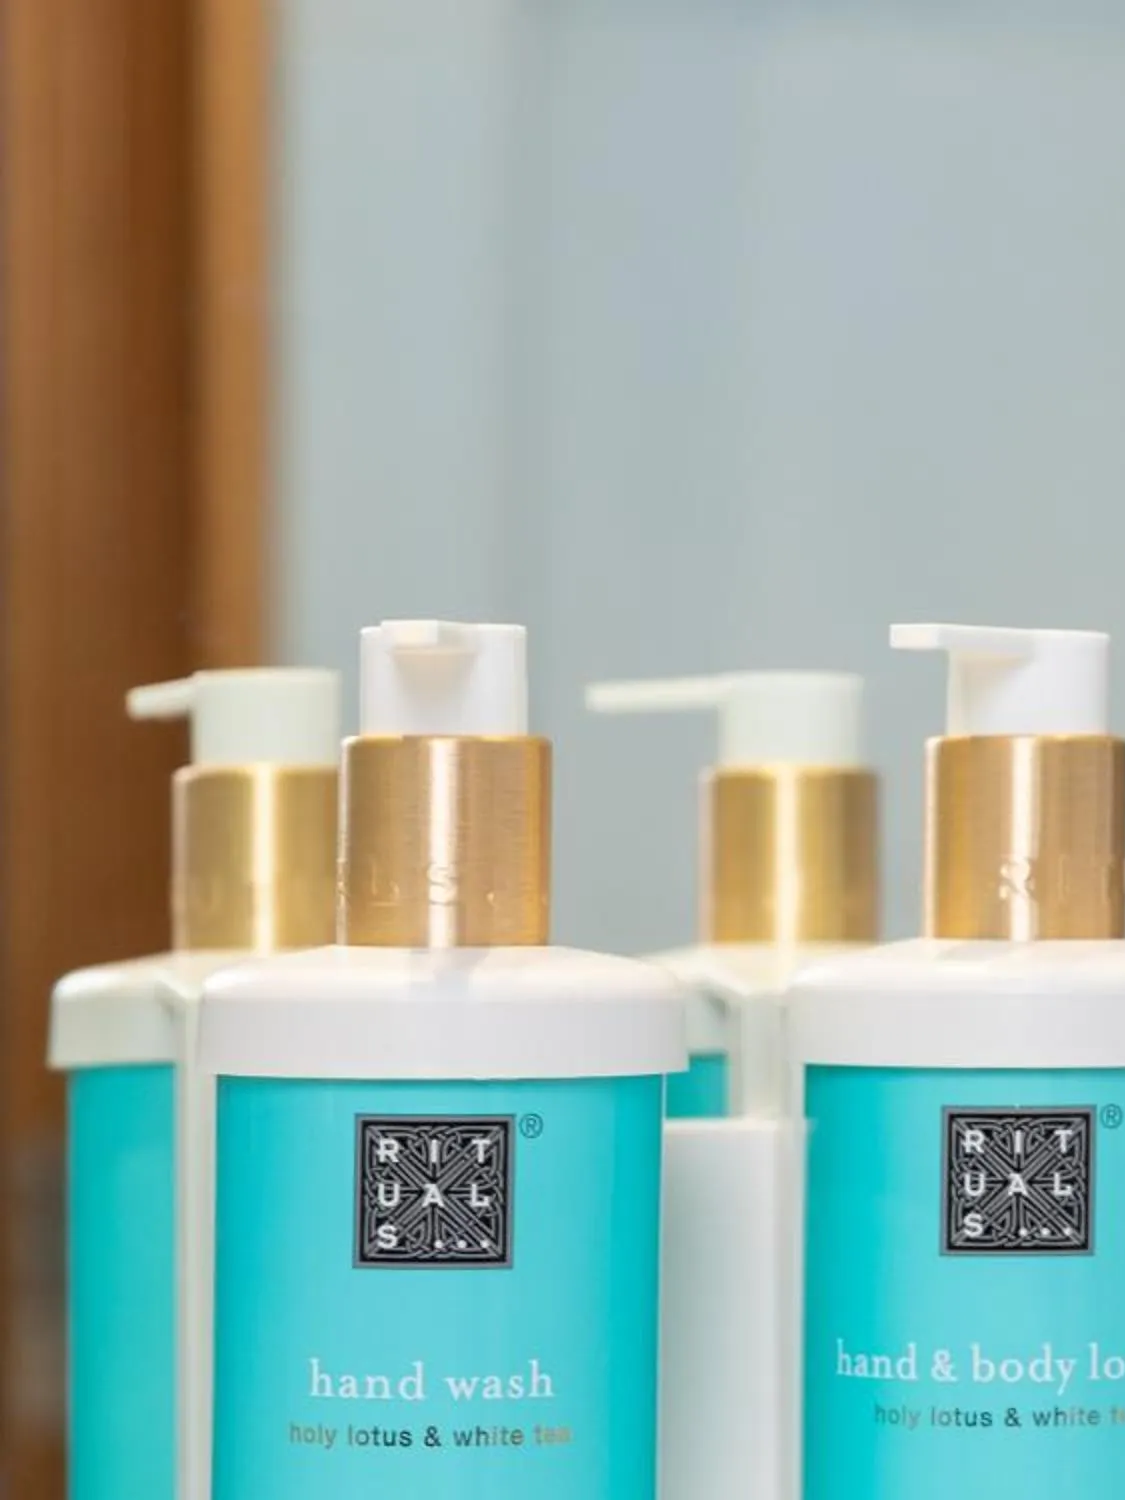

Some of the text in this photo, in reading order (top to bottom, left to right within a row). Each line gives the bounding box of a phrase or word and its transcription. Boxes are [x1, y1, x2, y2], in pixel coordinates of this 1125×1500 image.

[309, 1357, 555, 1401] hand wash
[836, 1338, 918, 1381] hand
[931, 1349, 958, 1382] &
[970, 1343, 1076, 1396] body
[874, 1404, 921, 1430] holy
[931, 1407, 993, 1427] lotus
[1003, 1407, 1021, 1427] &
[1032, 1406, 1100, 1426] white
[289, 1422, 337, 1449] holy
[347, 1425, 412, 1446] lotus
[423, 1426, 441, 1447] &
[453, 1425, 524, 1446] white
